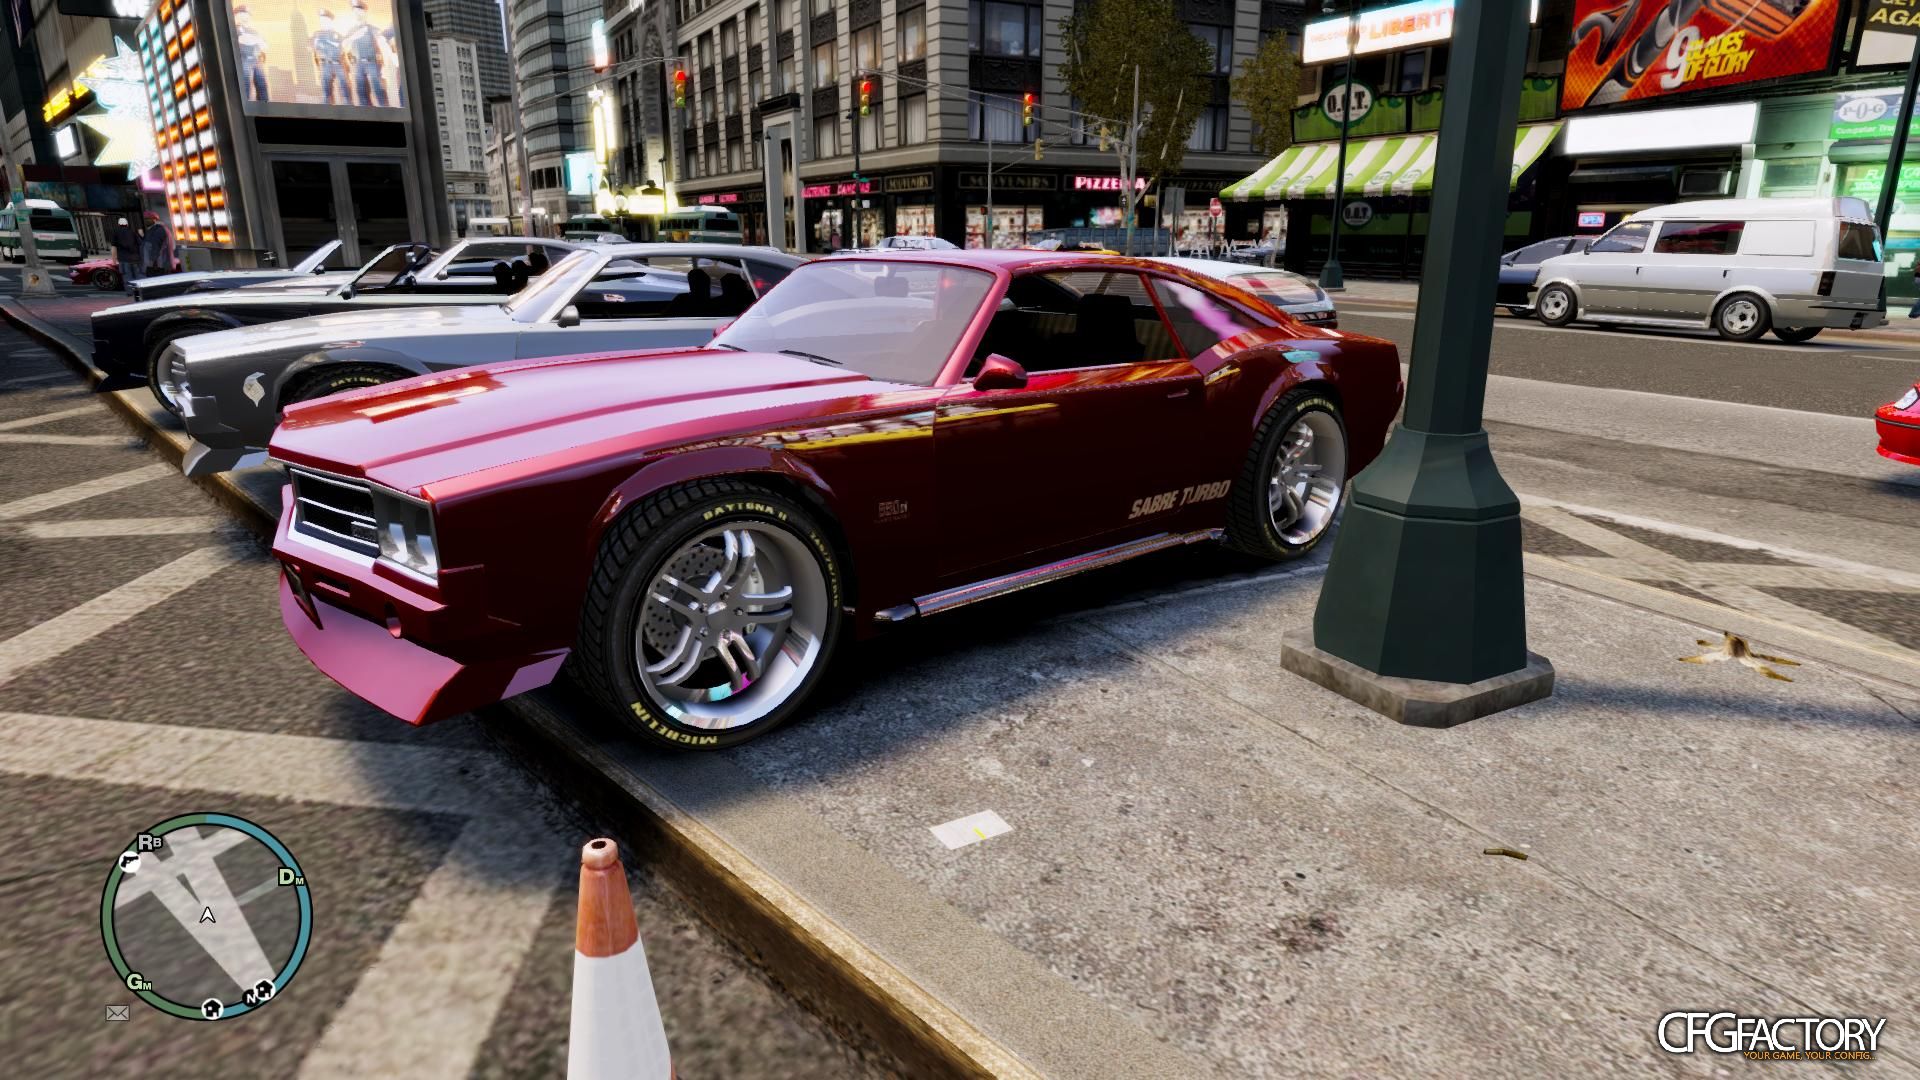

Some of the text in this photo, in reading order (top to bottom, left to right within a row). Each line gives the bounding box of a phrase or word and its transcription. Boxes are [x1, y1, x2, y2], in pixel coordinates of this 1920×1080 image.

[1660, 25, 1700, 89] 9
[1682, 48, 1756, 82] OF GLORY
[1327, 91, 1369, 113] O..T.
[838, 182, 870, 195] CAMEAS
[1075, 176, 1145, 190] PIZZEIA
[703, 502, 775, 521] DAYTONA
[1128, 479, 1231, 520] SABRE TURBO
[630, 701, 718, 745] MICHELIN
